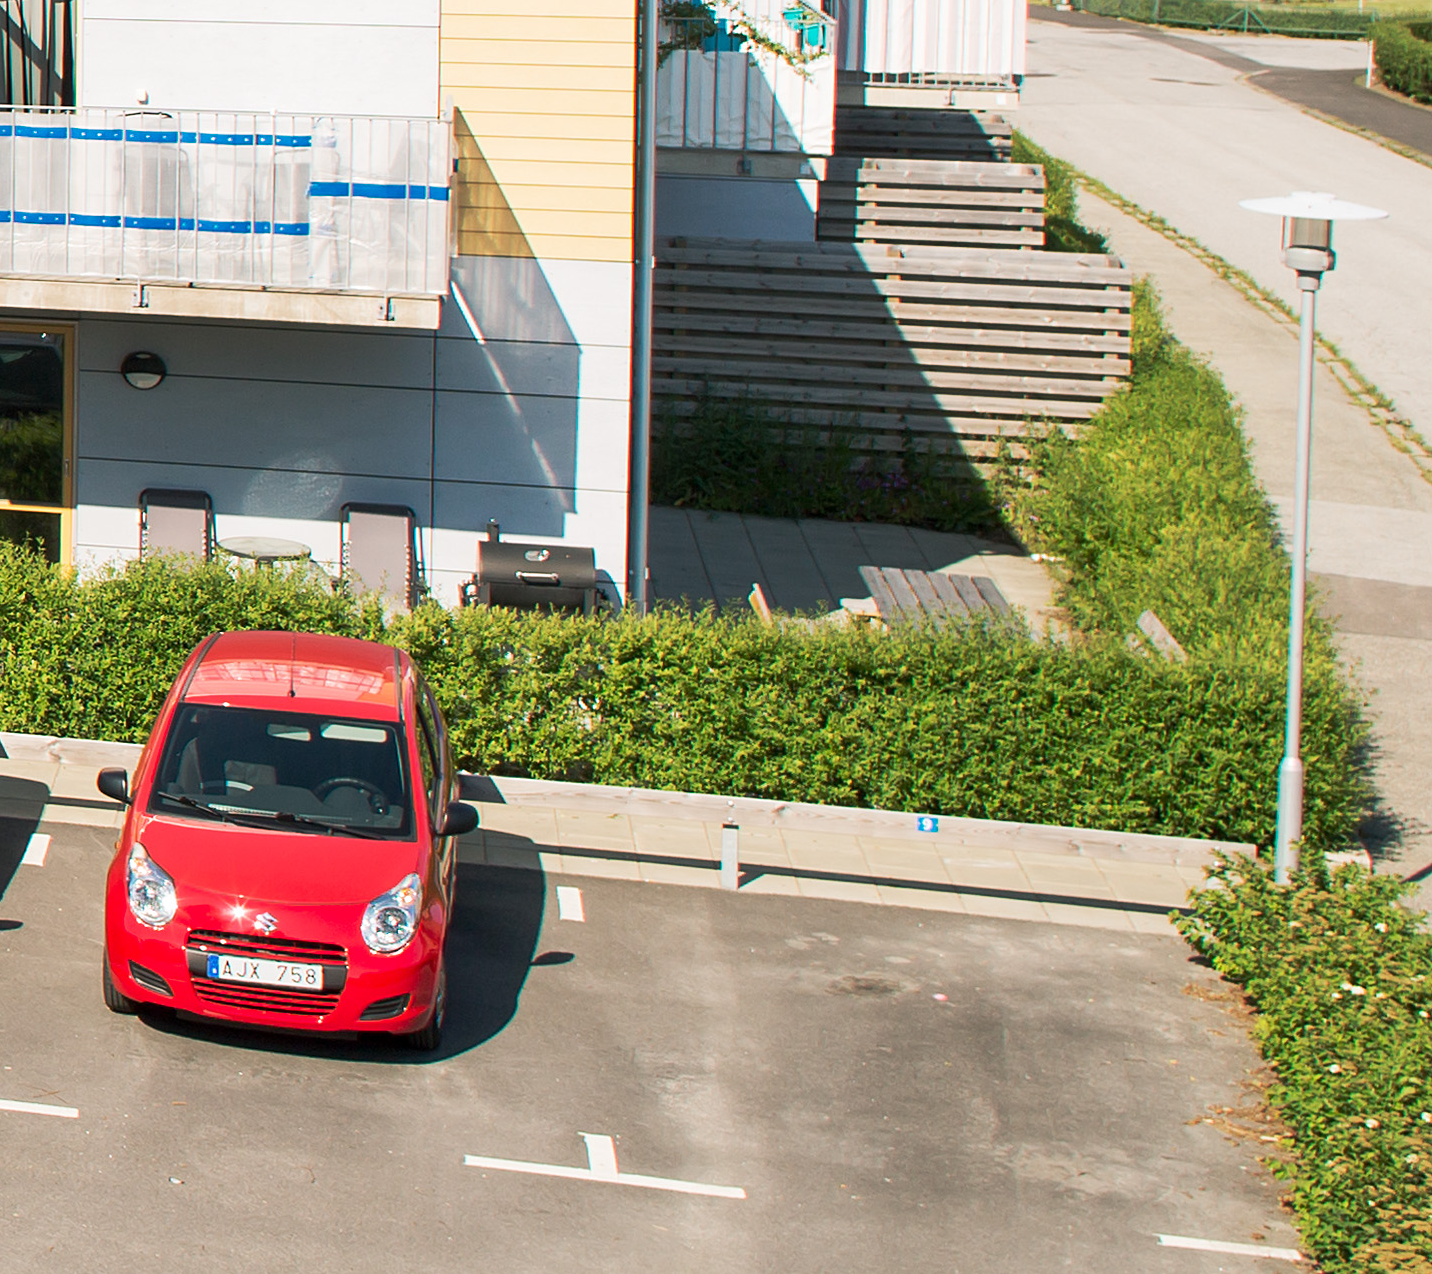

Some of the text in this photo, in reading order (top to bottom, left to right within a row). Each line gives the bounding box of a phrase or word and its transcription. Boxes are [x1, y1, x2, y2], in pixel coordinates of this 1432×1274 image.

[922, 817, 933, 831] 9
[222, 960, 317, 984] AJX 758
